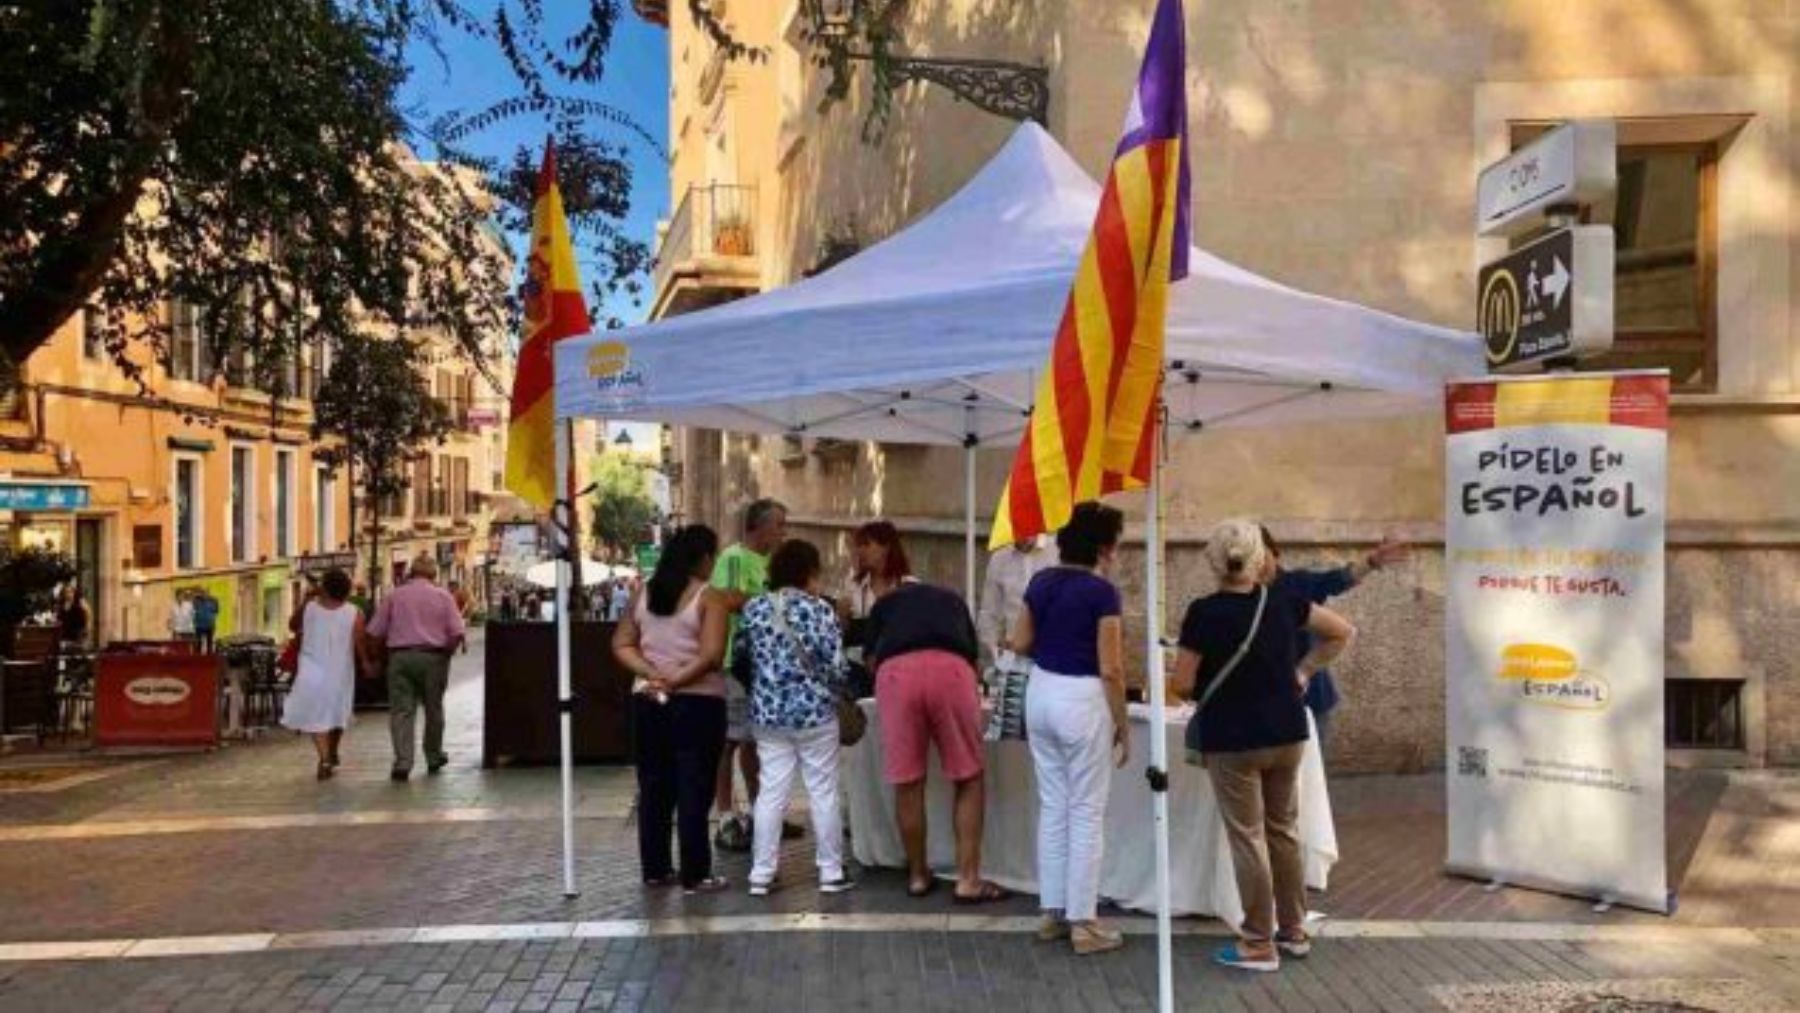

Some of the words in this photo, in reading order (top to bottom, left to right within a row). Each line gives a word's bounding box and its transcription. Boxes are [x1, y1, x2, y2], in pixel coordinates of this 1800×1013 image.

[1478, 442, 1577, 475] PÍDELO
[1589, 445, 1623, 473] EN
[1462, 476, 1645, 518] ESPAÑOL
[1545, 576, 1562, 594] TE
[1524, 679, 1603, 702] ESPAÑOL
